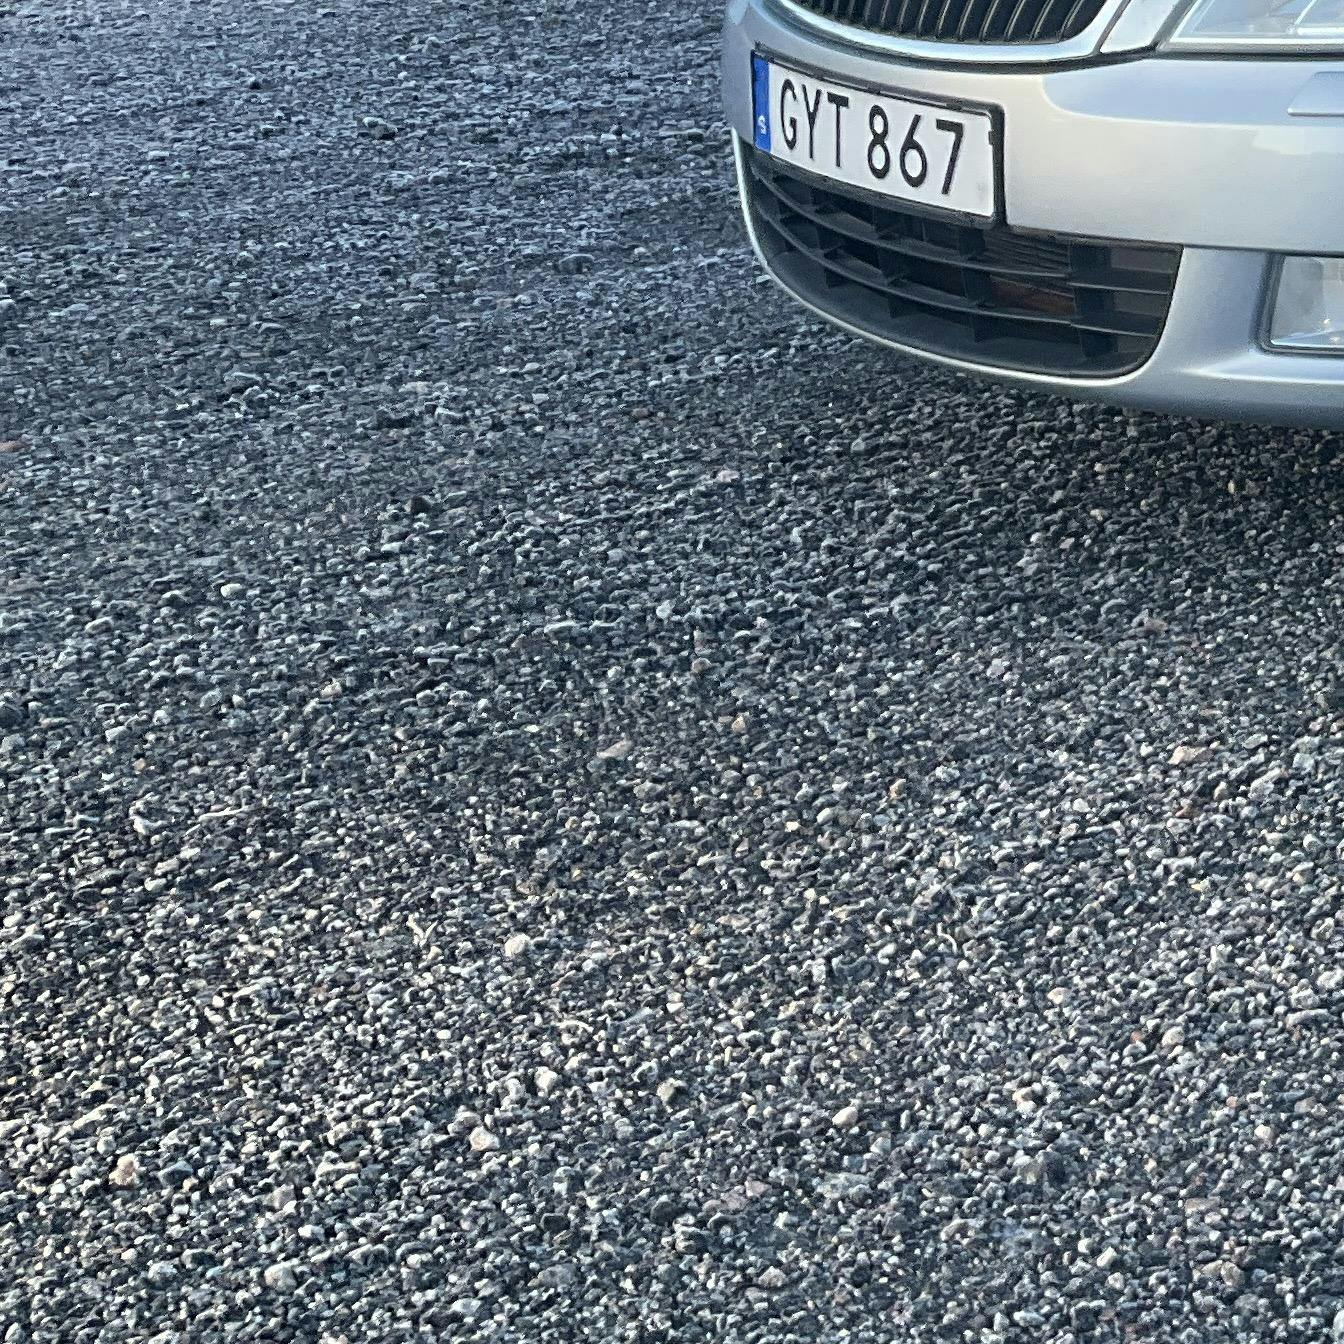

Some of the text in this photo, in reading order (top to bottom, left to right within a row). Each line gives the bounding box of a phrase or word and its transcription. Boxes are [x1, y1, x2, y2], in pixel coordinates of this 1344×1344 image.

[757, 114, 767, 136] S
[780, 78, 964, 195] GYT 867
